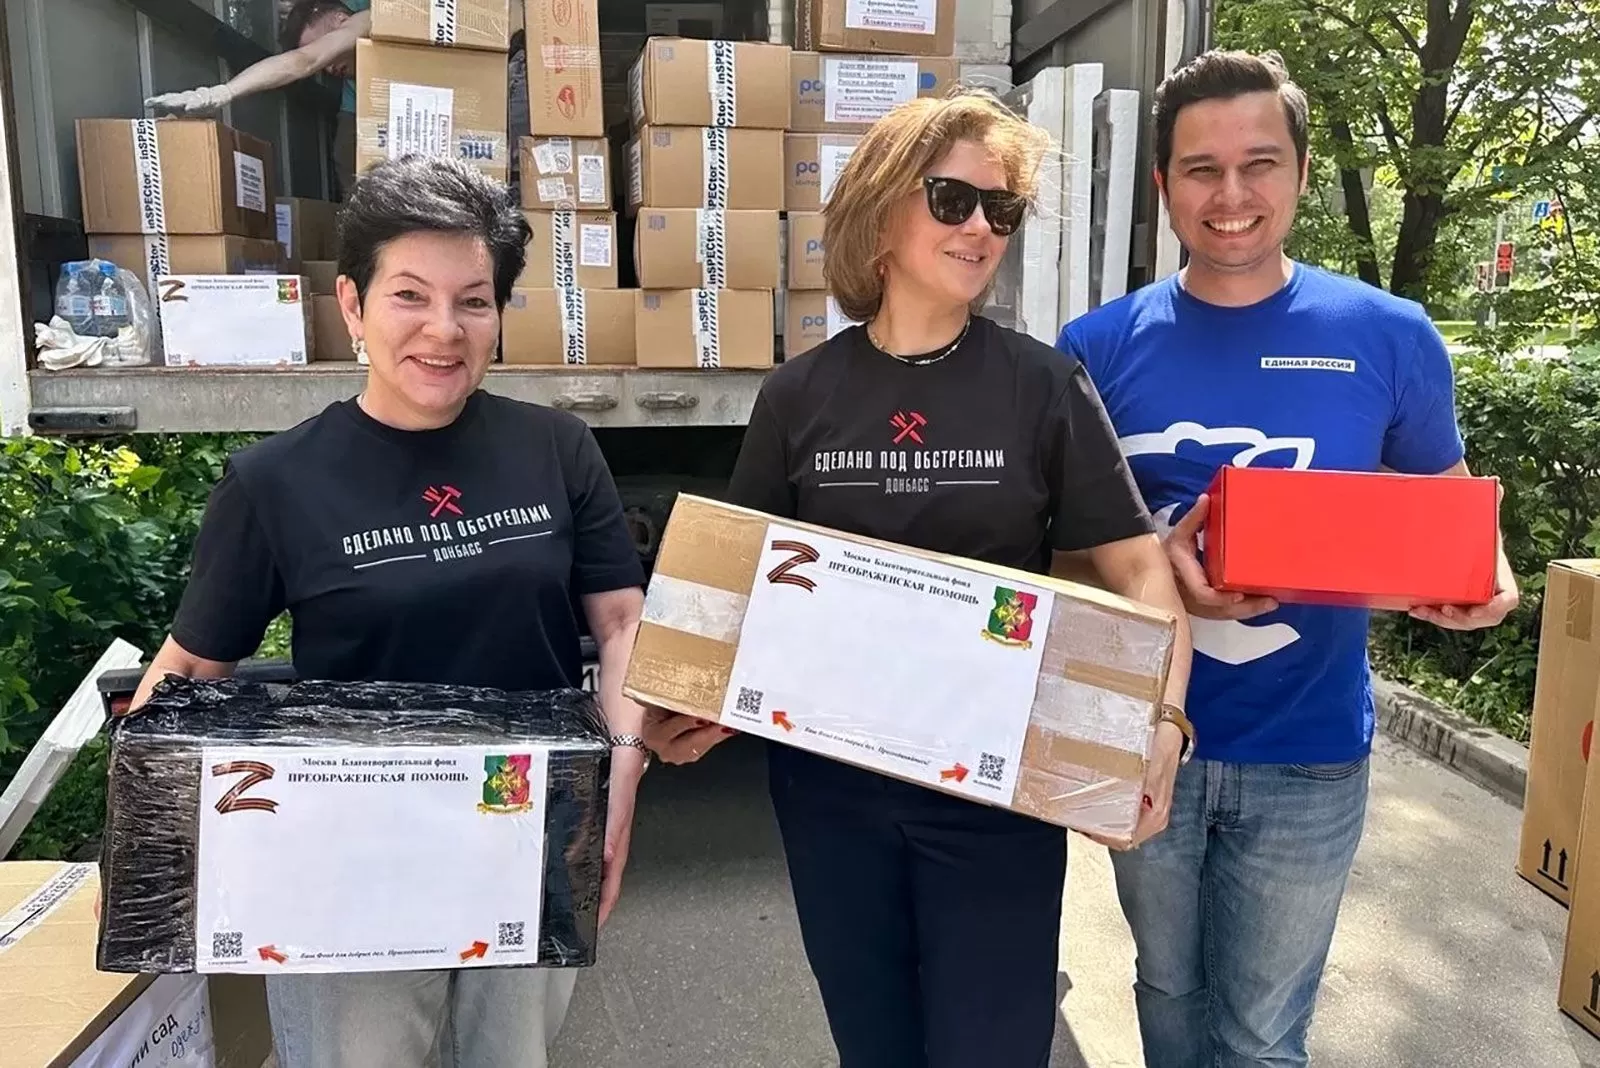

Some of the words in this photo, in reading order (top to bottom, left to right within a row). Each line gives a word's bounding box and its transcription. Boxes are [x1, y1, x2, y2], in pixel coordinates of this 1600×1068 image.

[143, 173, 155, 229] inSPECtor
[707, 225, 716, 284] inSPECtor
[1265, 359, 1308, 367] ЕДИНАЯ
[1311, 360, 1351, 369] РОССИЯ
[815, 450, 872, 472] СДЕЛАНО
[880, 450, 907, 472] ПОД
[914, 449, 1004, 469] ОБСТРЕЛАМИ
[885, 477, 930, 494] ДОНБАСС
[342, 526, 414, 556] СДЕЛАНО
[420, 521, 453, 543] ПОД
[456, 503, 552, 538] ОБСТРЕЛАМИ
[433, 541, 483, 562] ДОНБАСС
[843, 550, 871, 563] Москва
[874, 558, 950, 583] Благотворительный
[951, 577, 971, 588] фонд
[828, 561, 924, 592] ПРЕОБРАЖЕНСКАЯ
[928, 585, 979, 605] ПОМОЩЬ
[302, 757, 337, 766] Москва
[341, 756, 432, 768] Благотворительный
[434, 757, 457, 767] фонд
[288, 772, 405, 783] ПРЕОБРАЖЕНСКАЯ
[411, 772, 469, 783] ПОМОЩЬ
[152, 1014, 178, 1045] сад
